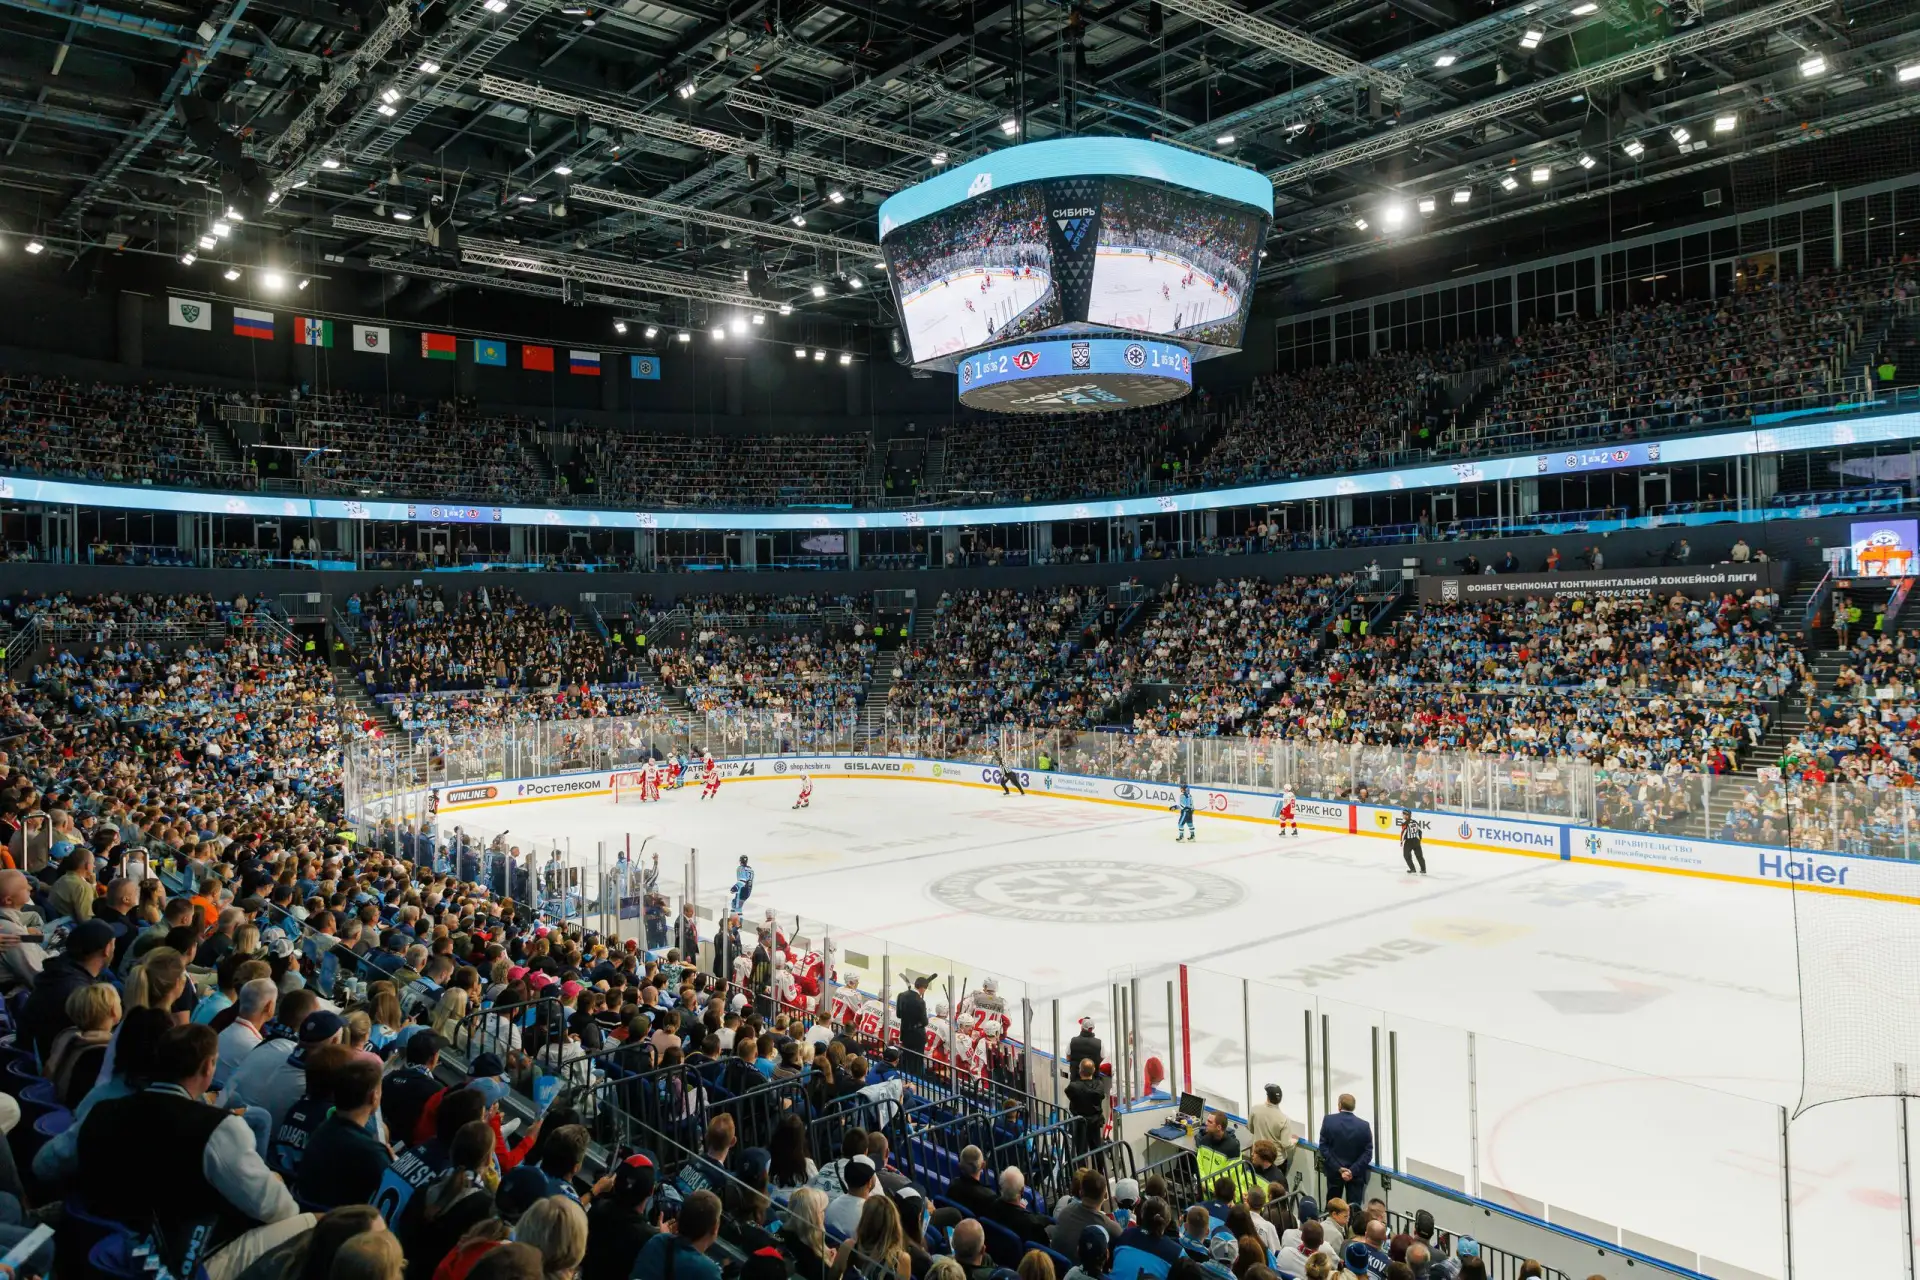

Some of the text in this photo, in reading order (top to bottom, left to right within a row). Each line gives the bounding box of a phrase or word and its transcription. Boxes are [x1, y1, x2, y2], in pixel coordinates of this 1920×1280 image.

[1052, 207, 1096, 219] СИБИРЬ
[1071, 218, 1093, 252] АРЕНА
[975, 360, 983, 379] 1
[999, 355, 1008, 375] 2
[1151, 349, 1160, 368] 1
[1174, 353, 1181, 371] 2
[1581, 454, 1588, 466] 1
[1601, 452, 1608, 464] 2
[443, 508, 449, 518] 1
[459, 509, 465, 519] 2
[1467, 573, 1758, 592] ФОНБЕТ ЧЕМПИОНАТ КОНТИНЕНТАЛЬНОЙ ХОККЕЙНОЙ ЛИГИ
[790, 762, 831, 773] shop.hcsibir.ru
[844, 762, 900, 771] GISLAVED
[982, 768, 1030, 787] СОЗ
[449, 789, 486, 802] WINLINE
[527, 781, 601, 796] Ростелеком
[1145, 789, 1176, 803] LADA
[1322, 806, 1342, 818] НСО
[1477, 827, 1554, 847] ТЕХНОПАН
[1614, 839, 1693, 853] ПРАВИТЕЛЬСТВО
[1759, 853, 1849, 885] Haier
[861, 1011, 880, 1035] 15
